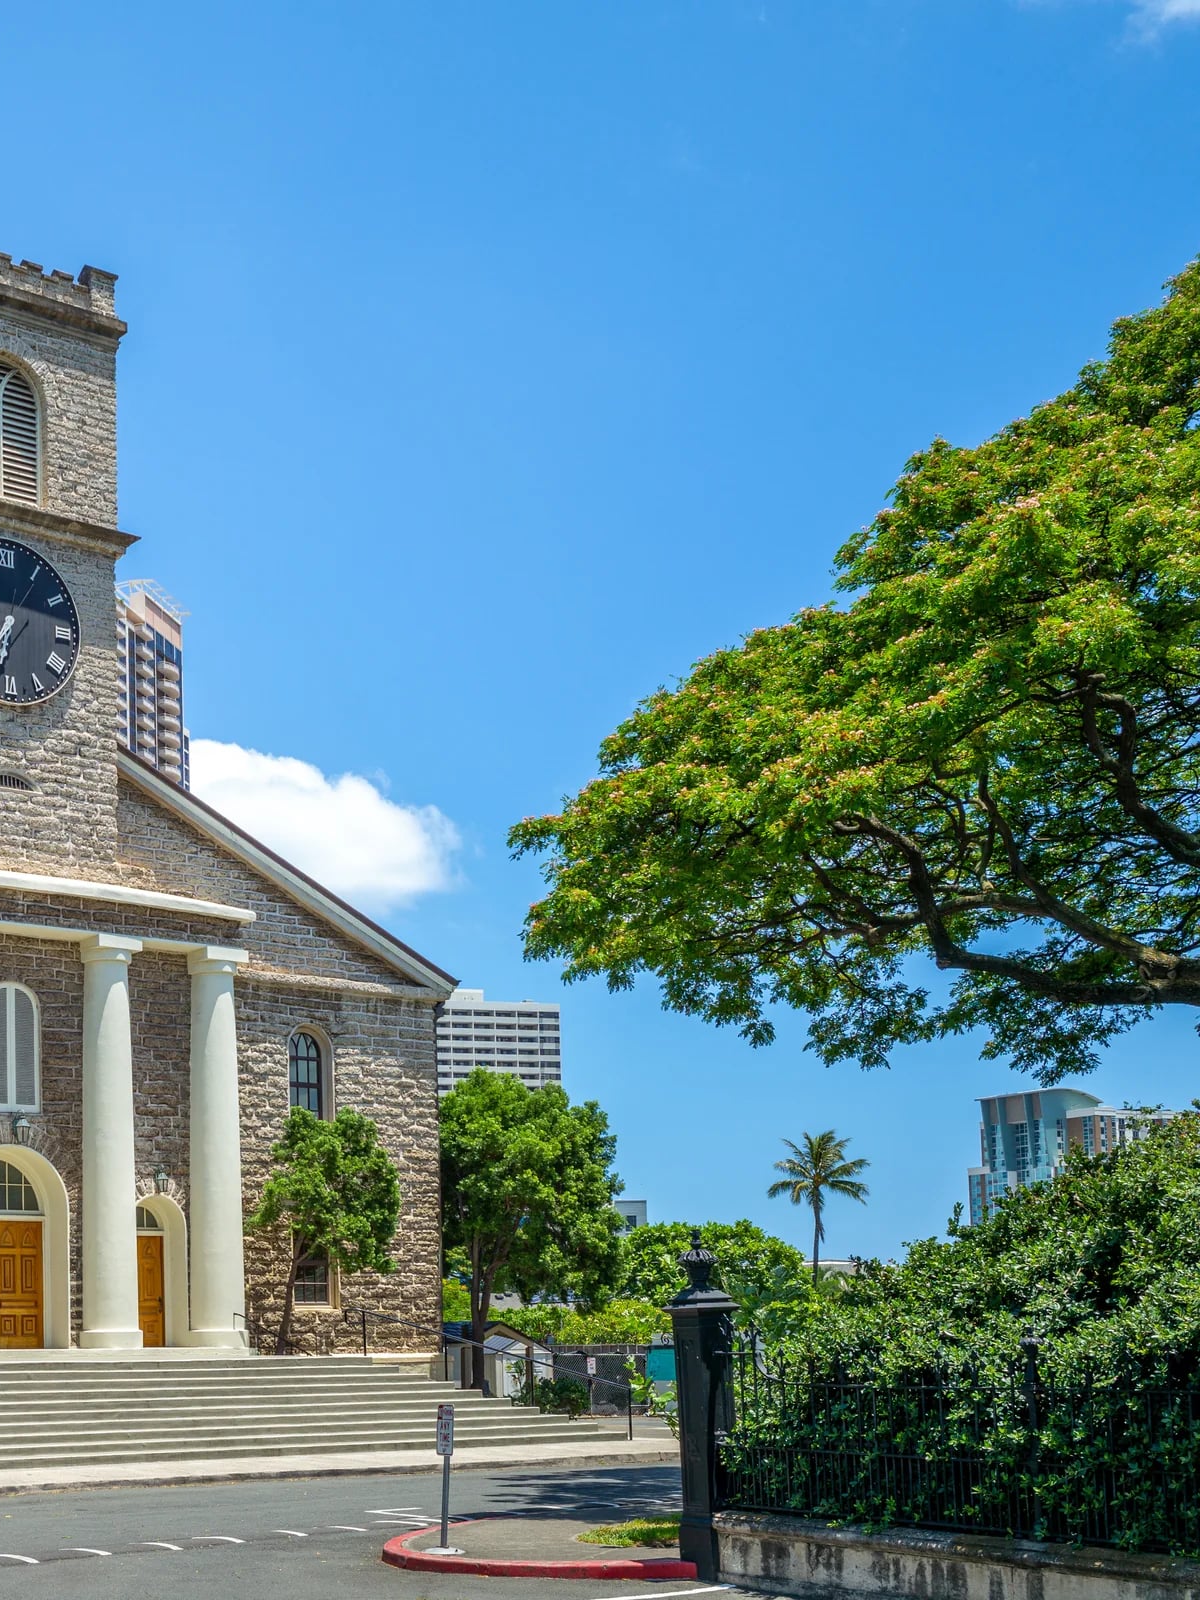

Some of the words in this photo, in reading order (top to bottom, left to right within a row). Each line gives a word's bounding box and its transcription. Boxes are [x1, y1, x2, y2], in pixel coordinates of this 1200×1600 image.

[29, 565, 40, 581] I
[48, 593, 63, 607] II
[55, 625, 71, 640] III
[46, 651, 66, 674] IIII
[5, 675, 18, 696] VI
[31, 673, 44, 692] V
[440, 1421, 450, 1431] ANY
[439, 1432, 450, 1443] TIME
